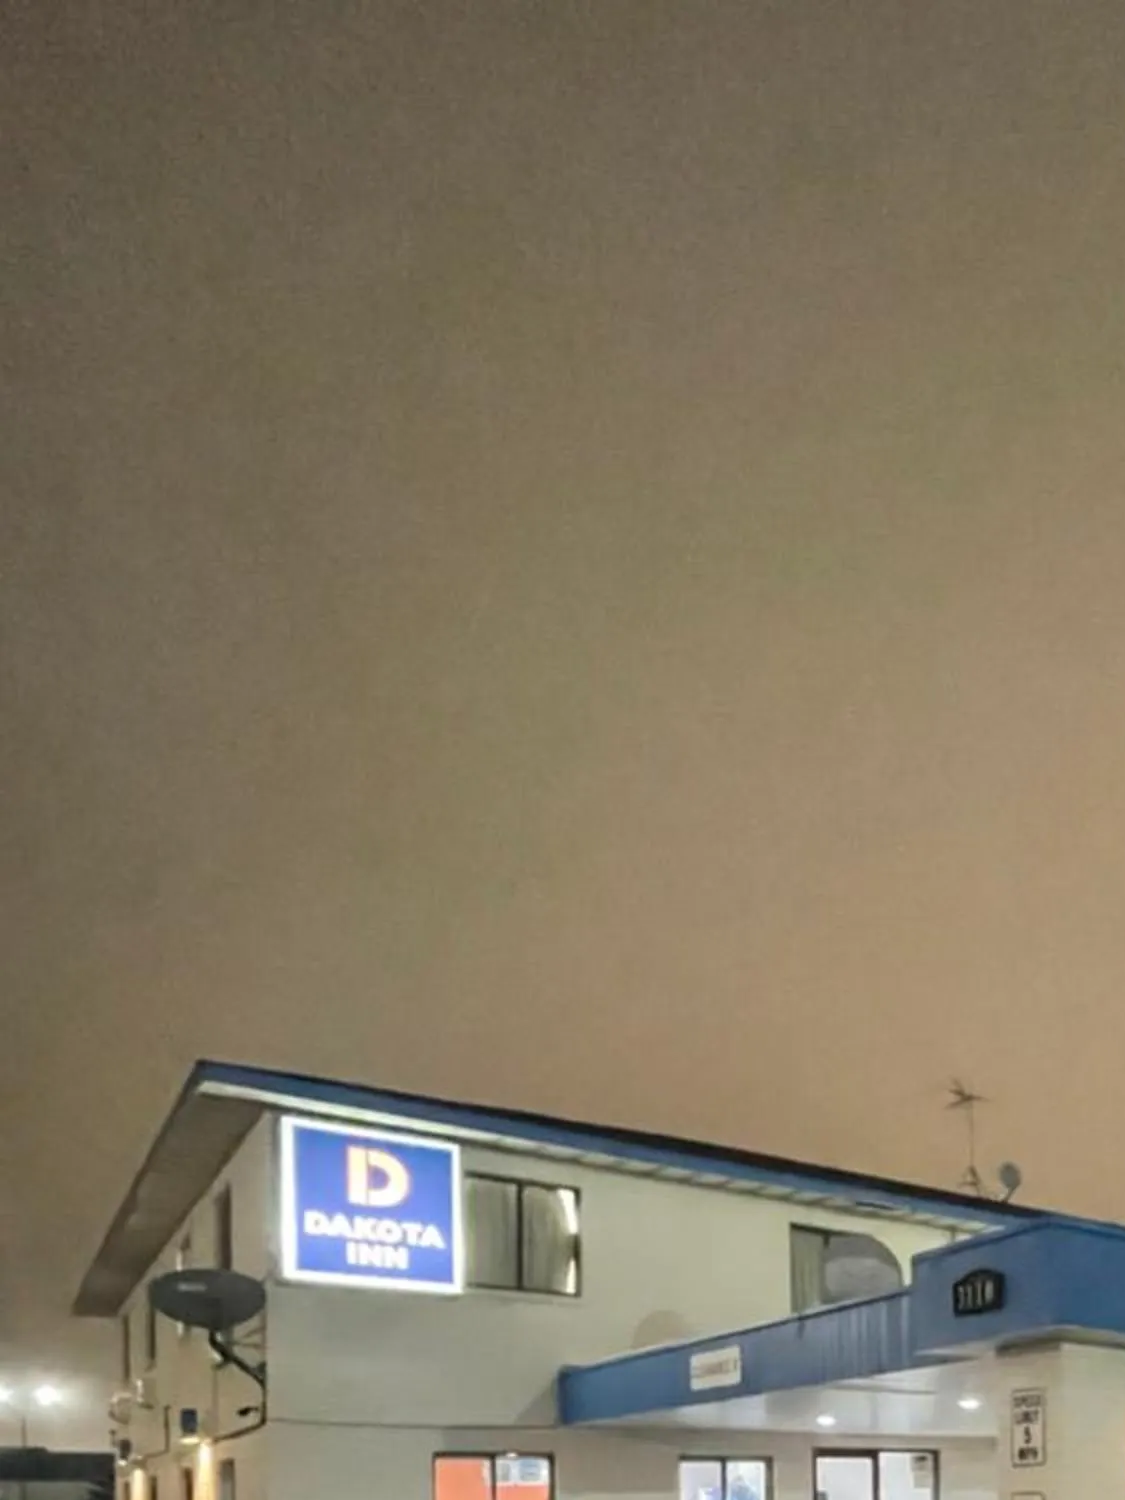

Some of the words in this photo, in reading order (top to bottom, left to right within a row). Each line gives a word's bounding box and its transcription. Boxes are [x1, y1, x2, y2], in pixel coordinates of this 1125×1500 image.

[347, 1146, 411, 1207] D
[303, 1210, 446, 1249] DAKOTA
[346, 1242, 409, 1270] INN
[1024, 1426, 1033, 1444] 5
